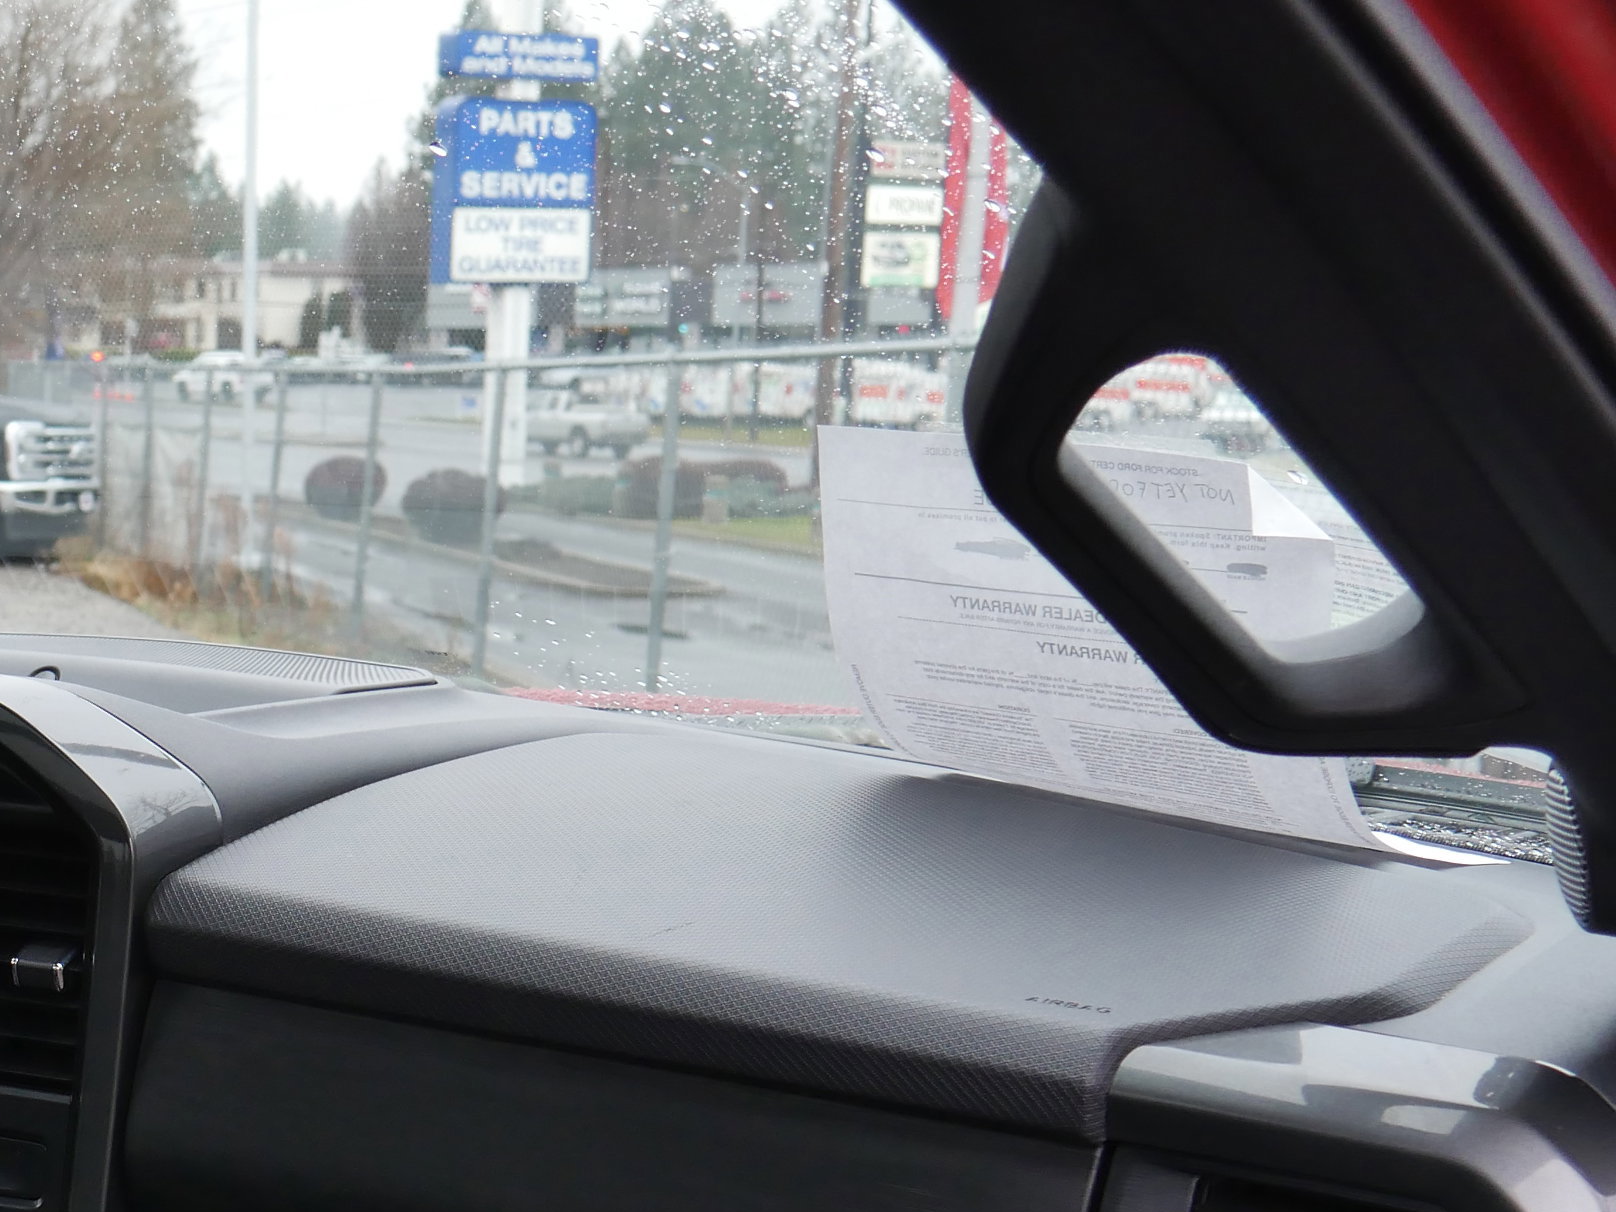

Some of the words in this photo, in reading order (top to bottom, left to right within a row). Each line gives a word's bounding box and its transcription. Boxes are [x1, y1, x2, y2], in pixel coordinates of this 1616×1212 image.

[479, 107, 575, 140] PARTS
[515, 140, 537, 168] &
[460, 170, 588, 200] SERVICE
[464, 214, 512, 233] LOW
[458, 255, 582, 274] GUARANTEE
